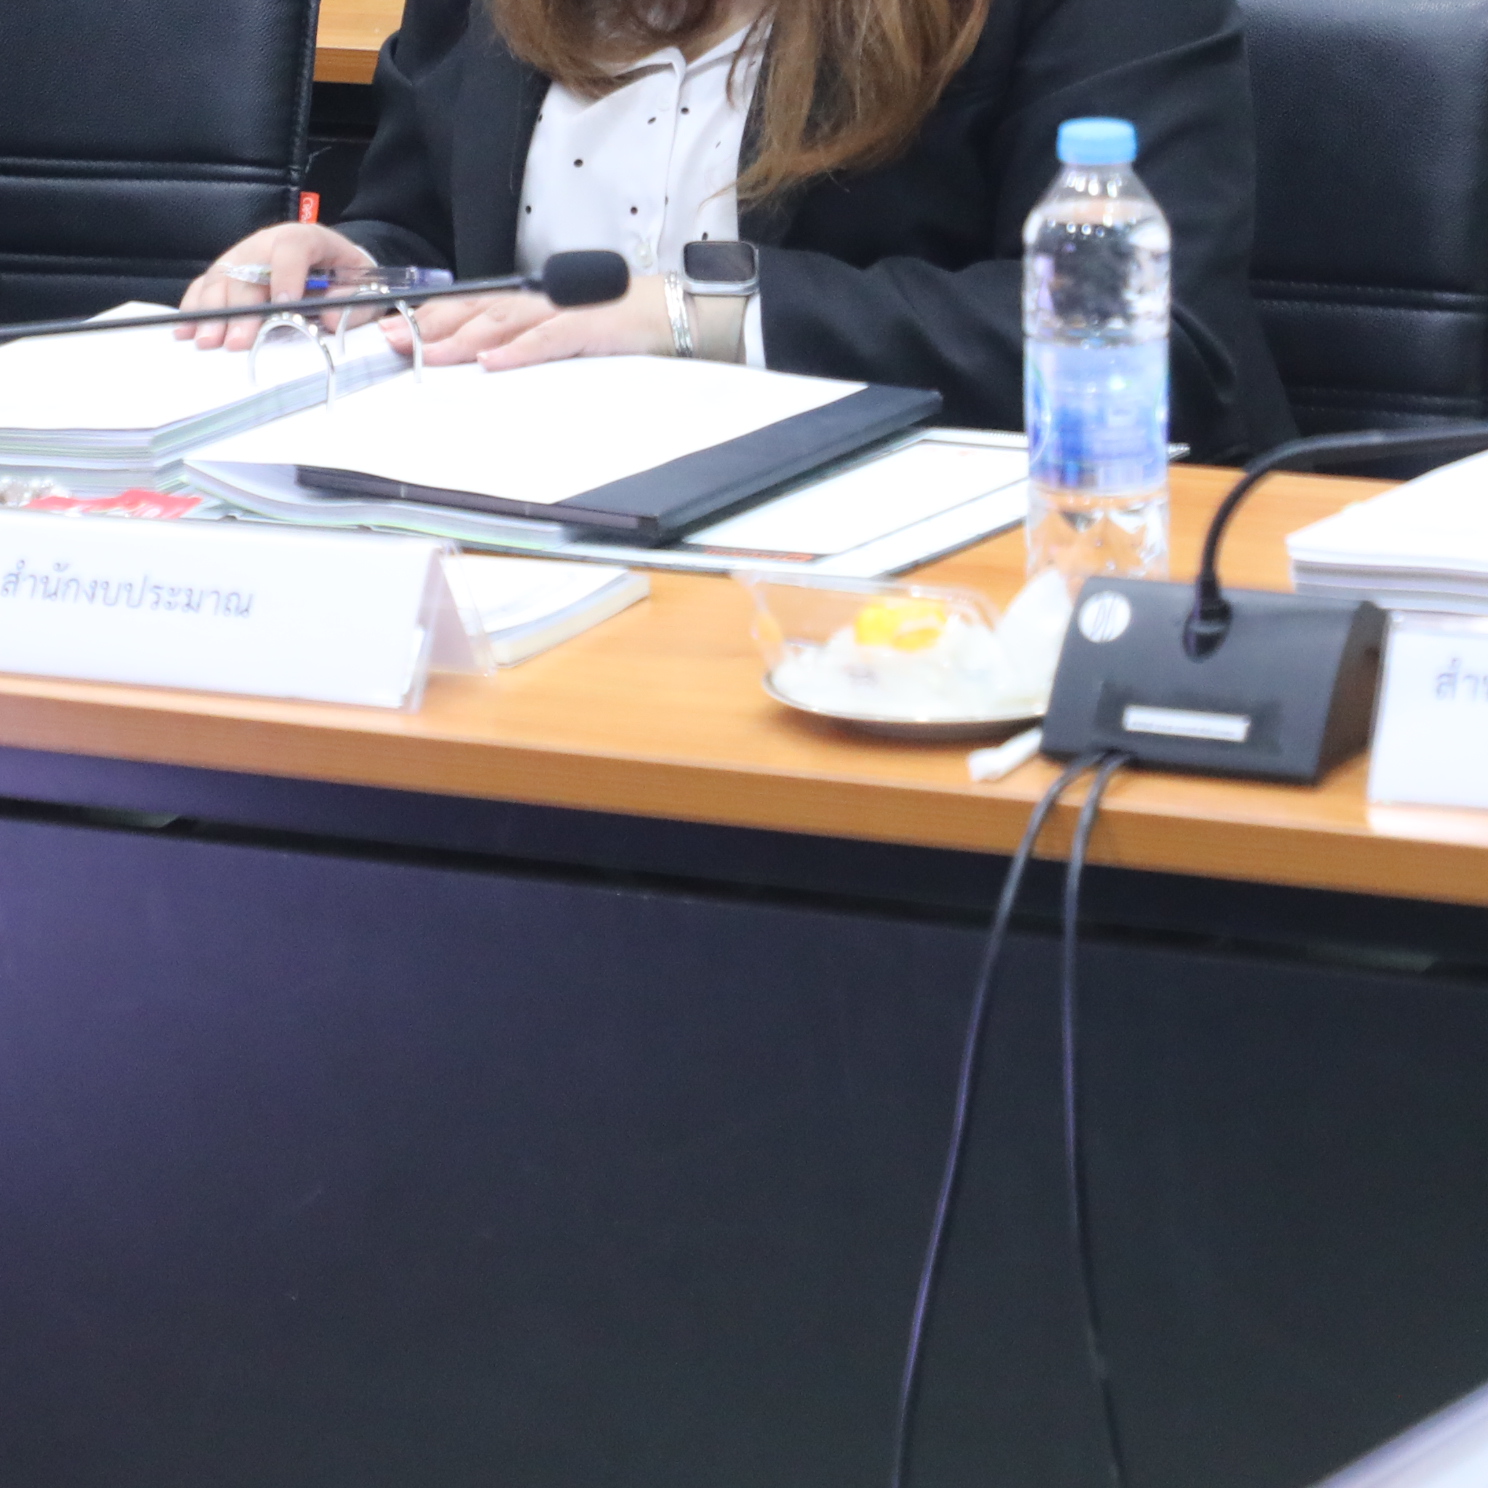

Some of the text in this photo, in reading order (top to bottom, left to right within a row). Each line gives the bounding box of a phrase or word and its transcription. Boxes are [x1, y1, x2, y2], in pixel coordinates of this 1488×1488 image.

[0, 559, 254, 618] สำนักงบประมาณ
